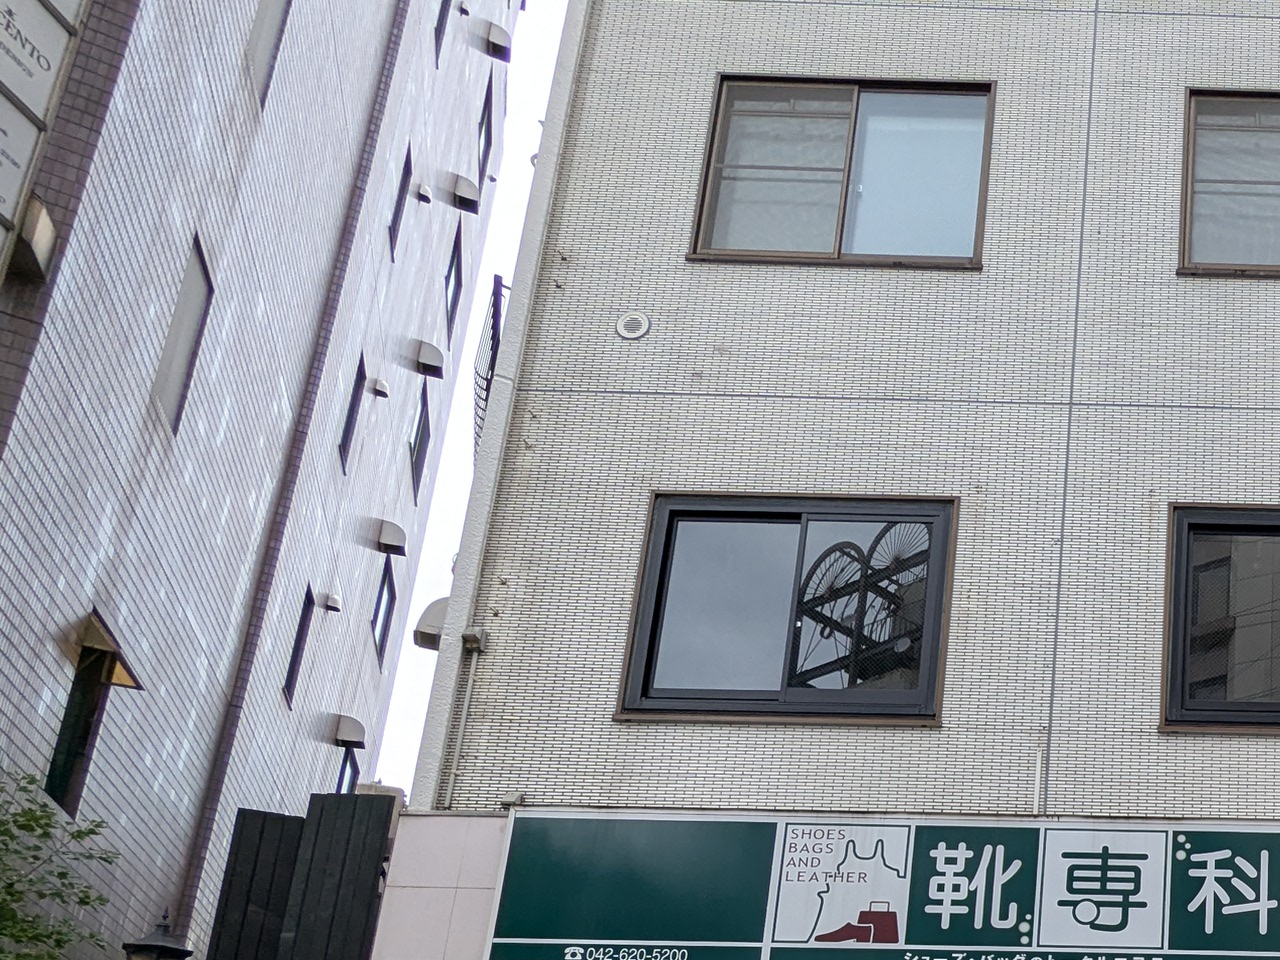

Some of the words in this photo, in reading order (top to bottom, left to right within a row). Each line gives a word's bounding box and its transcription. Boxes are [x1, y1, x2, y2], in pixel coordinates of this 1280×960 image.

[789, 827, 847, 841] SHOES
[788, 841, 834, 855] BAGS
[785, 856, 821, 869] AND
[785, 870, 868, 884] LEATHER
[923, 840, 1279, 936] 靴専科
